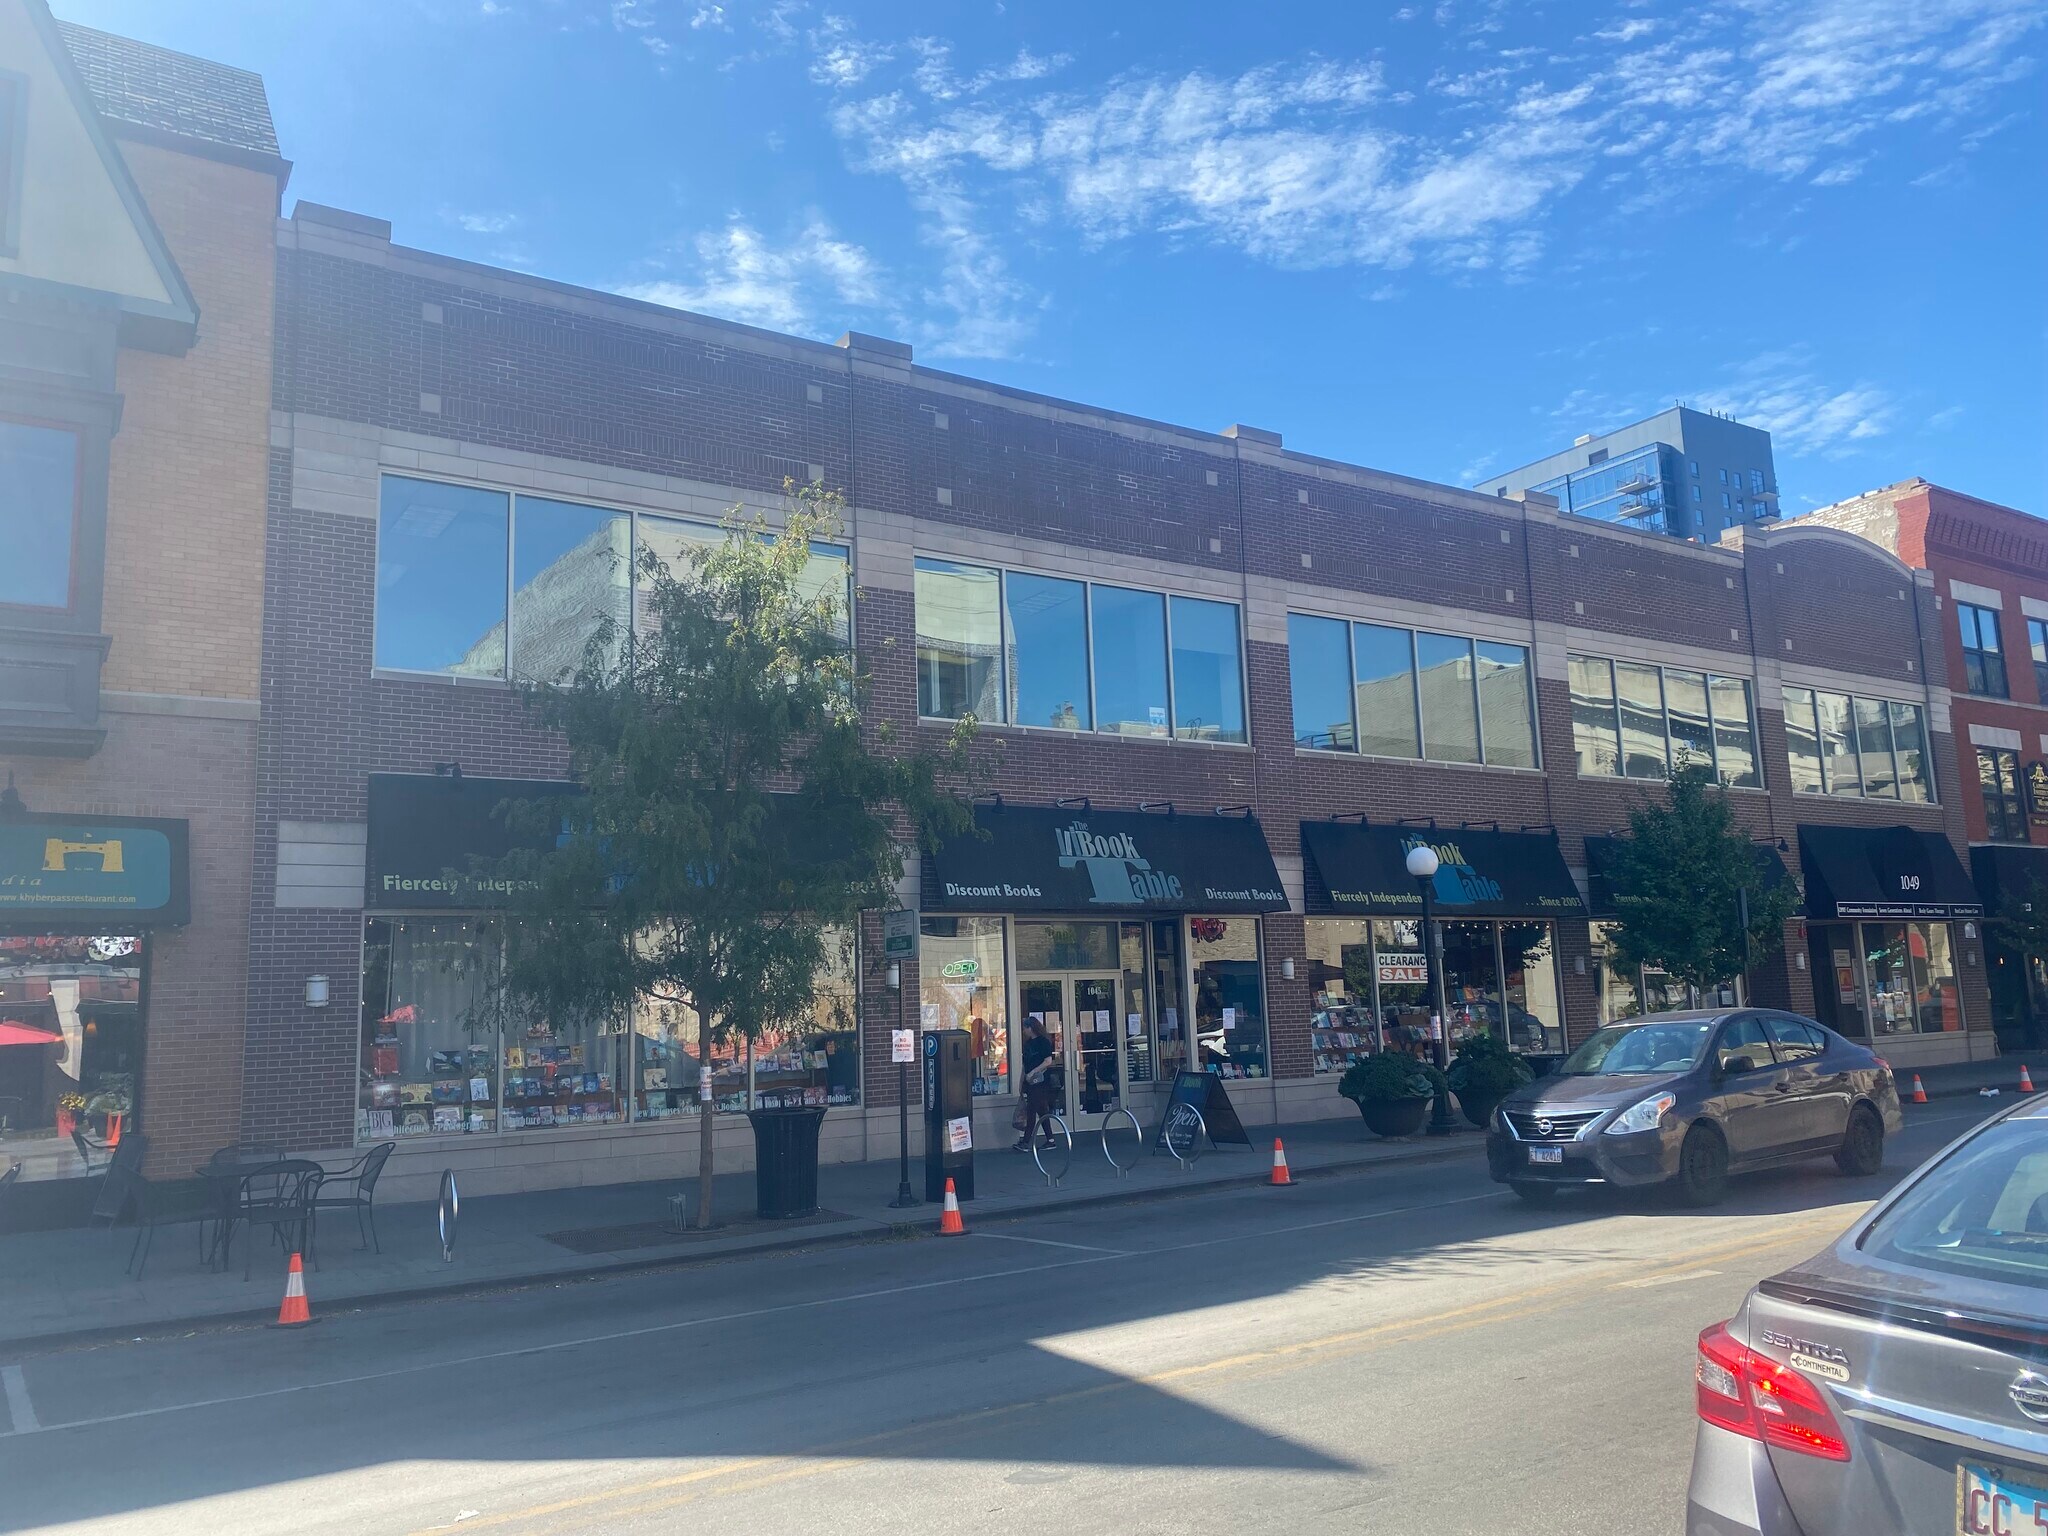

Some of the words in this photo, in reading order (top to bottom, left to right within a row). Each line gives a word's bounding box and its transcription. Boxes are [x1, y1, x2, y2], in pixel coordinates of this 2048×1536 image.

[1072, 821, 1089, 831] The
[1081, 831, 1141, 859] Book
[1058, 856, 1184, 904] Table
[1900, 875, 1920, 890] 1049
[946, 883, 1001, 898] Discount
[1003, 884, 1042, 898] Books
[1205, 888, 1251, 900] Discount
[1252, 888, 1284, 902] Books
[1331, 890, 1370, 906] Fiercely
[1371, 891, 1423, 906] Independen
[1562, 897, 1582, 908] 2003
[1379, 956, 1426, 966] CLEARANC
[1382, 969, 1428, 980] SALE
[371, 1111, 391, 1128] BIG
[1762, 1329, 1850, 1365] SENTRA
[1796, 1355, 1844, 1378] CONTINENTAL
[1971, 1489, 2011, 1536] CC
